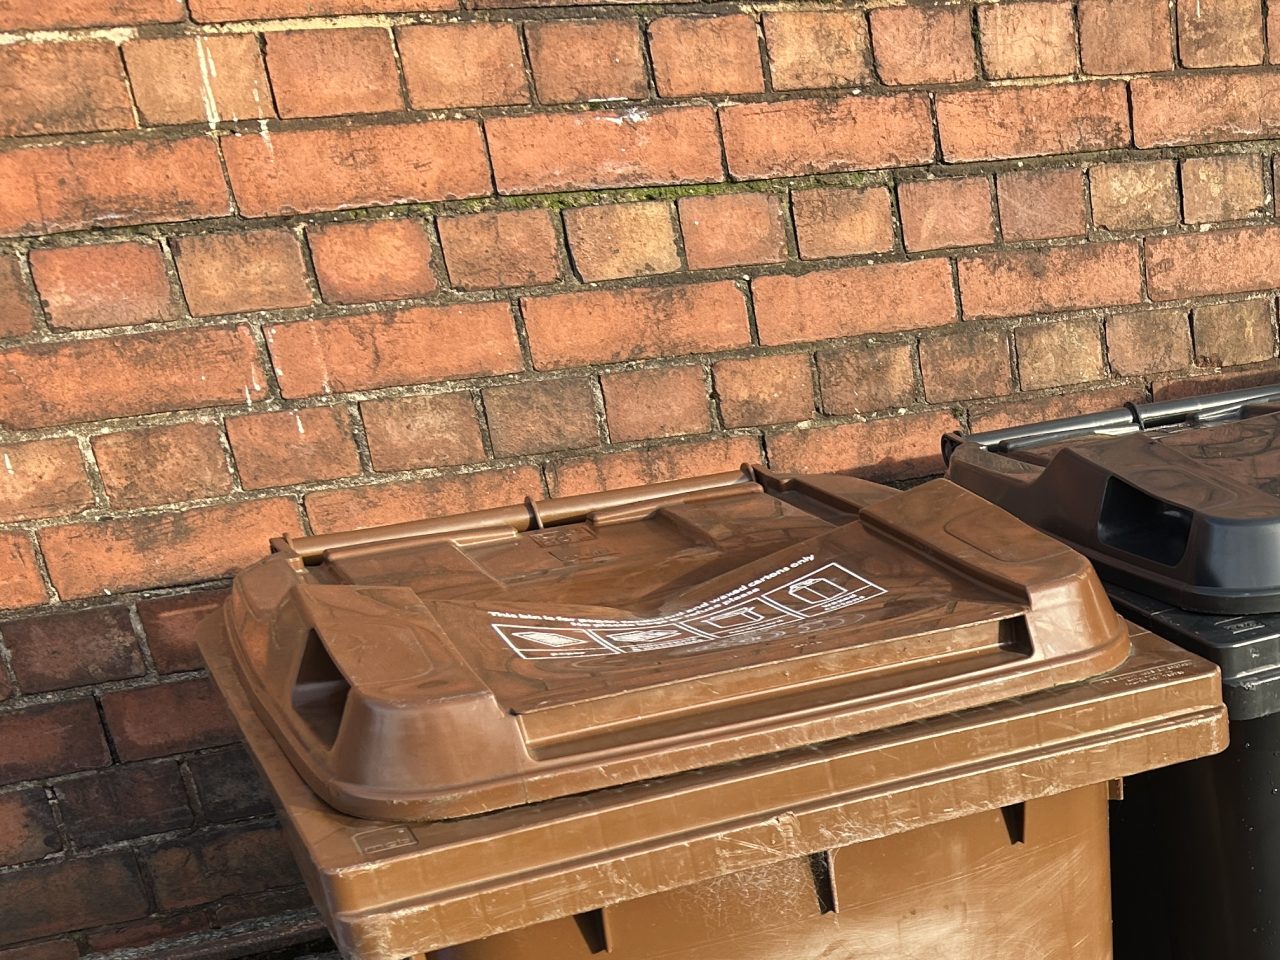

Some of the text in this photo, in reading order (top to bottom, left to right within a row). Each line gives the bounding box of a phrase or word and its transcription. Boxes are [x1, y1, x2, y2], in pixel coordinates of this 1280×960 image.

[488, 611, 518, 619] This
[709, 585, 748, 603] waxed
[748, 567, 790, 587] cartons
[790, 554, 815, 568] only
